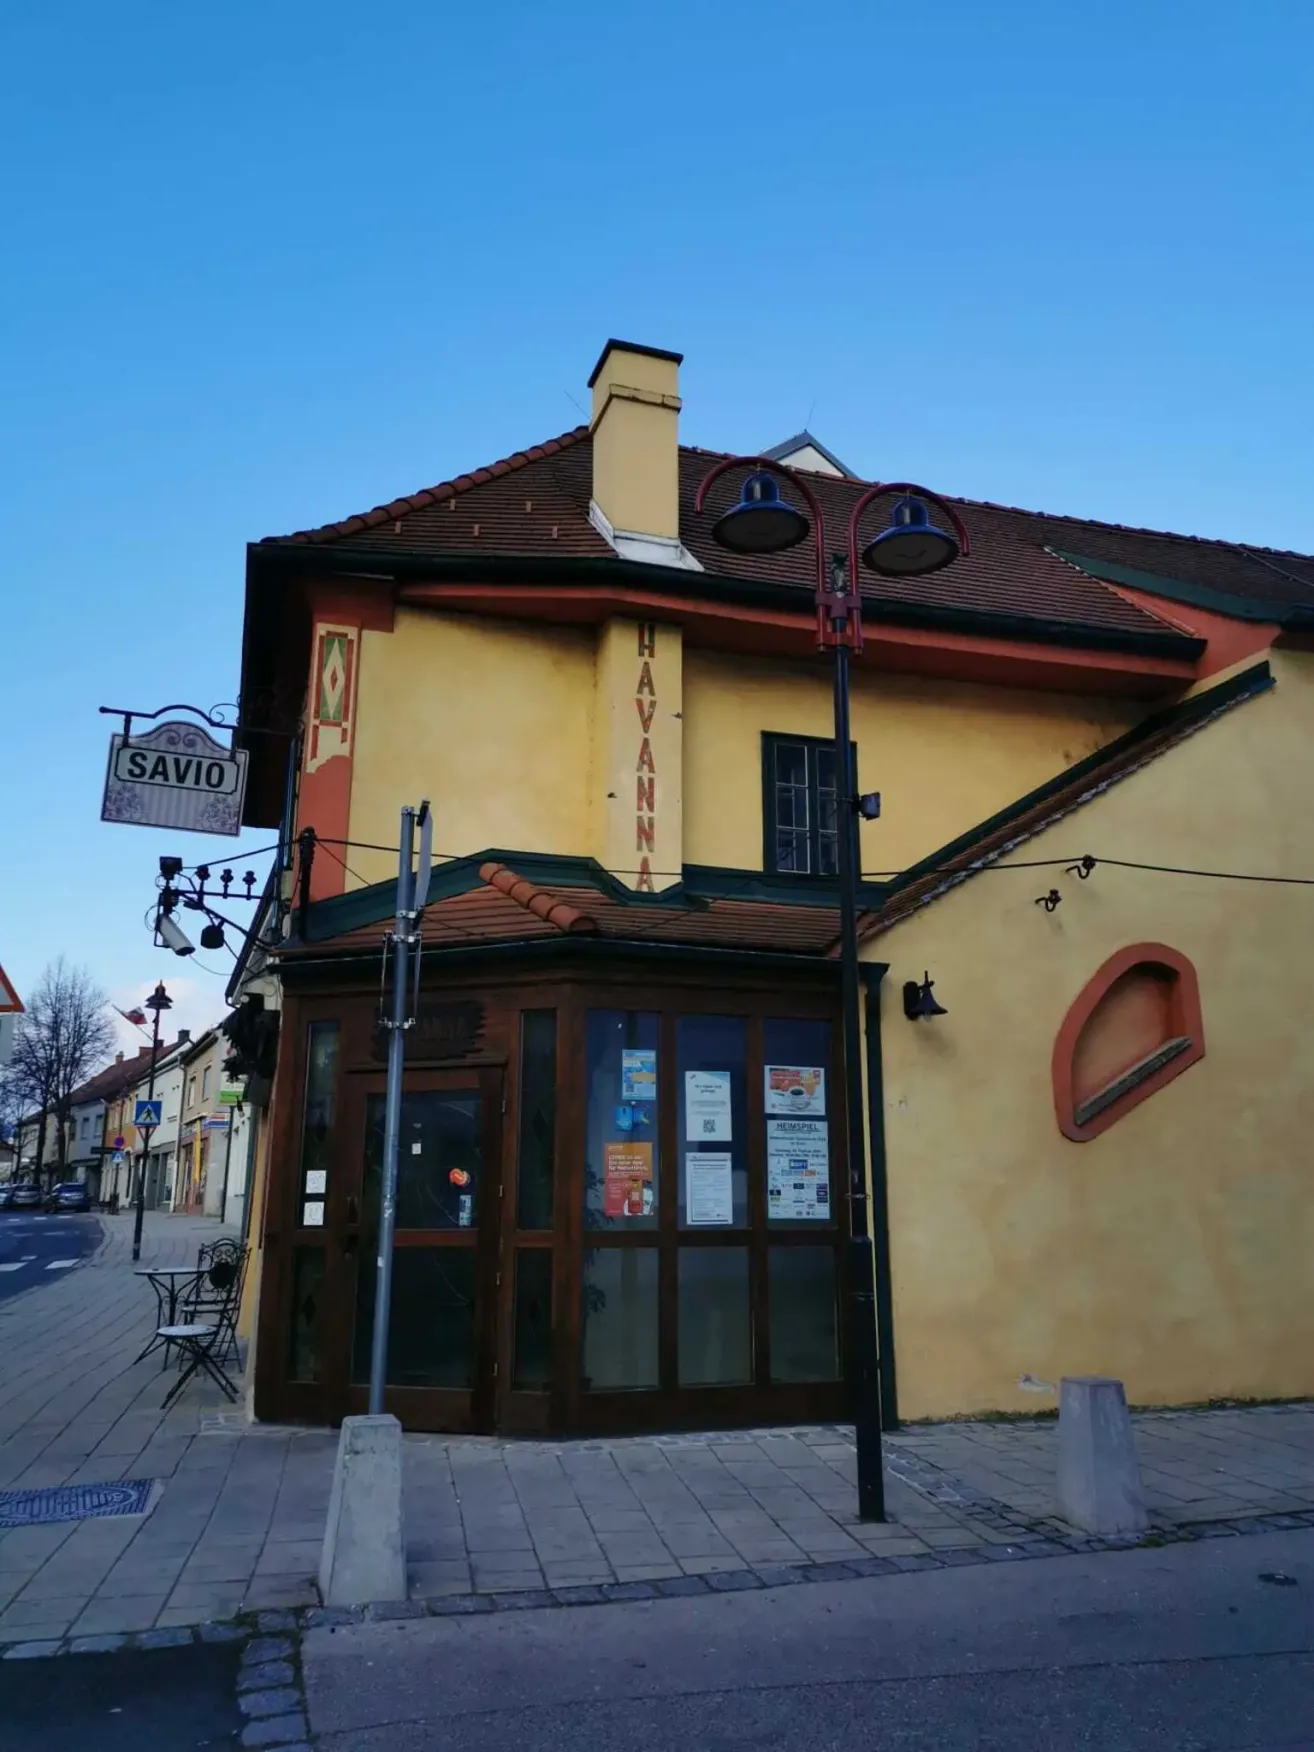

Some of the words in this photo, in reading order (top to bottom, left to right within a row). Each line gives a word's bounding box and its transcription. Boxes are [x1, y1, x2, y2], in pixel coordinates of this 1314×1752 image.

[127, 751, 225, 789] SAVIO
[635, 622, 658, 892] HAVANNA
[776, 1122, 817, 1130] HEIMSPIEL
